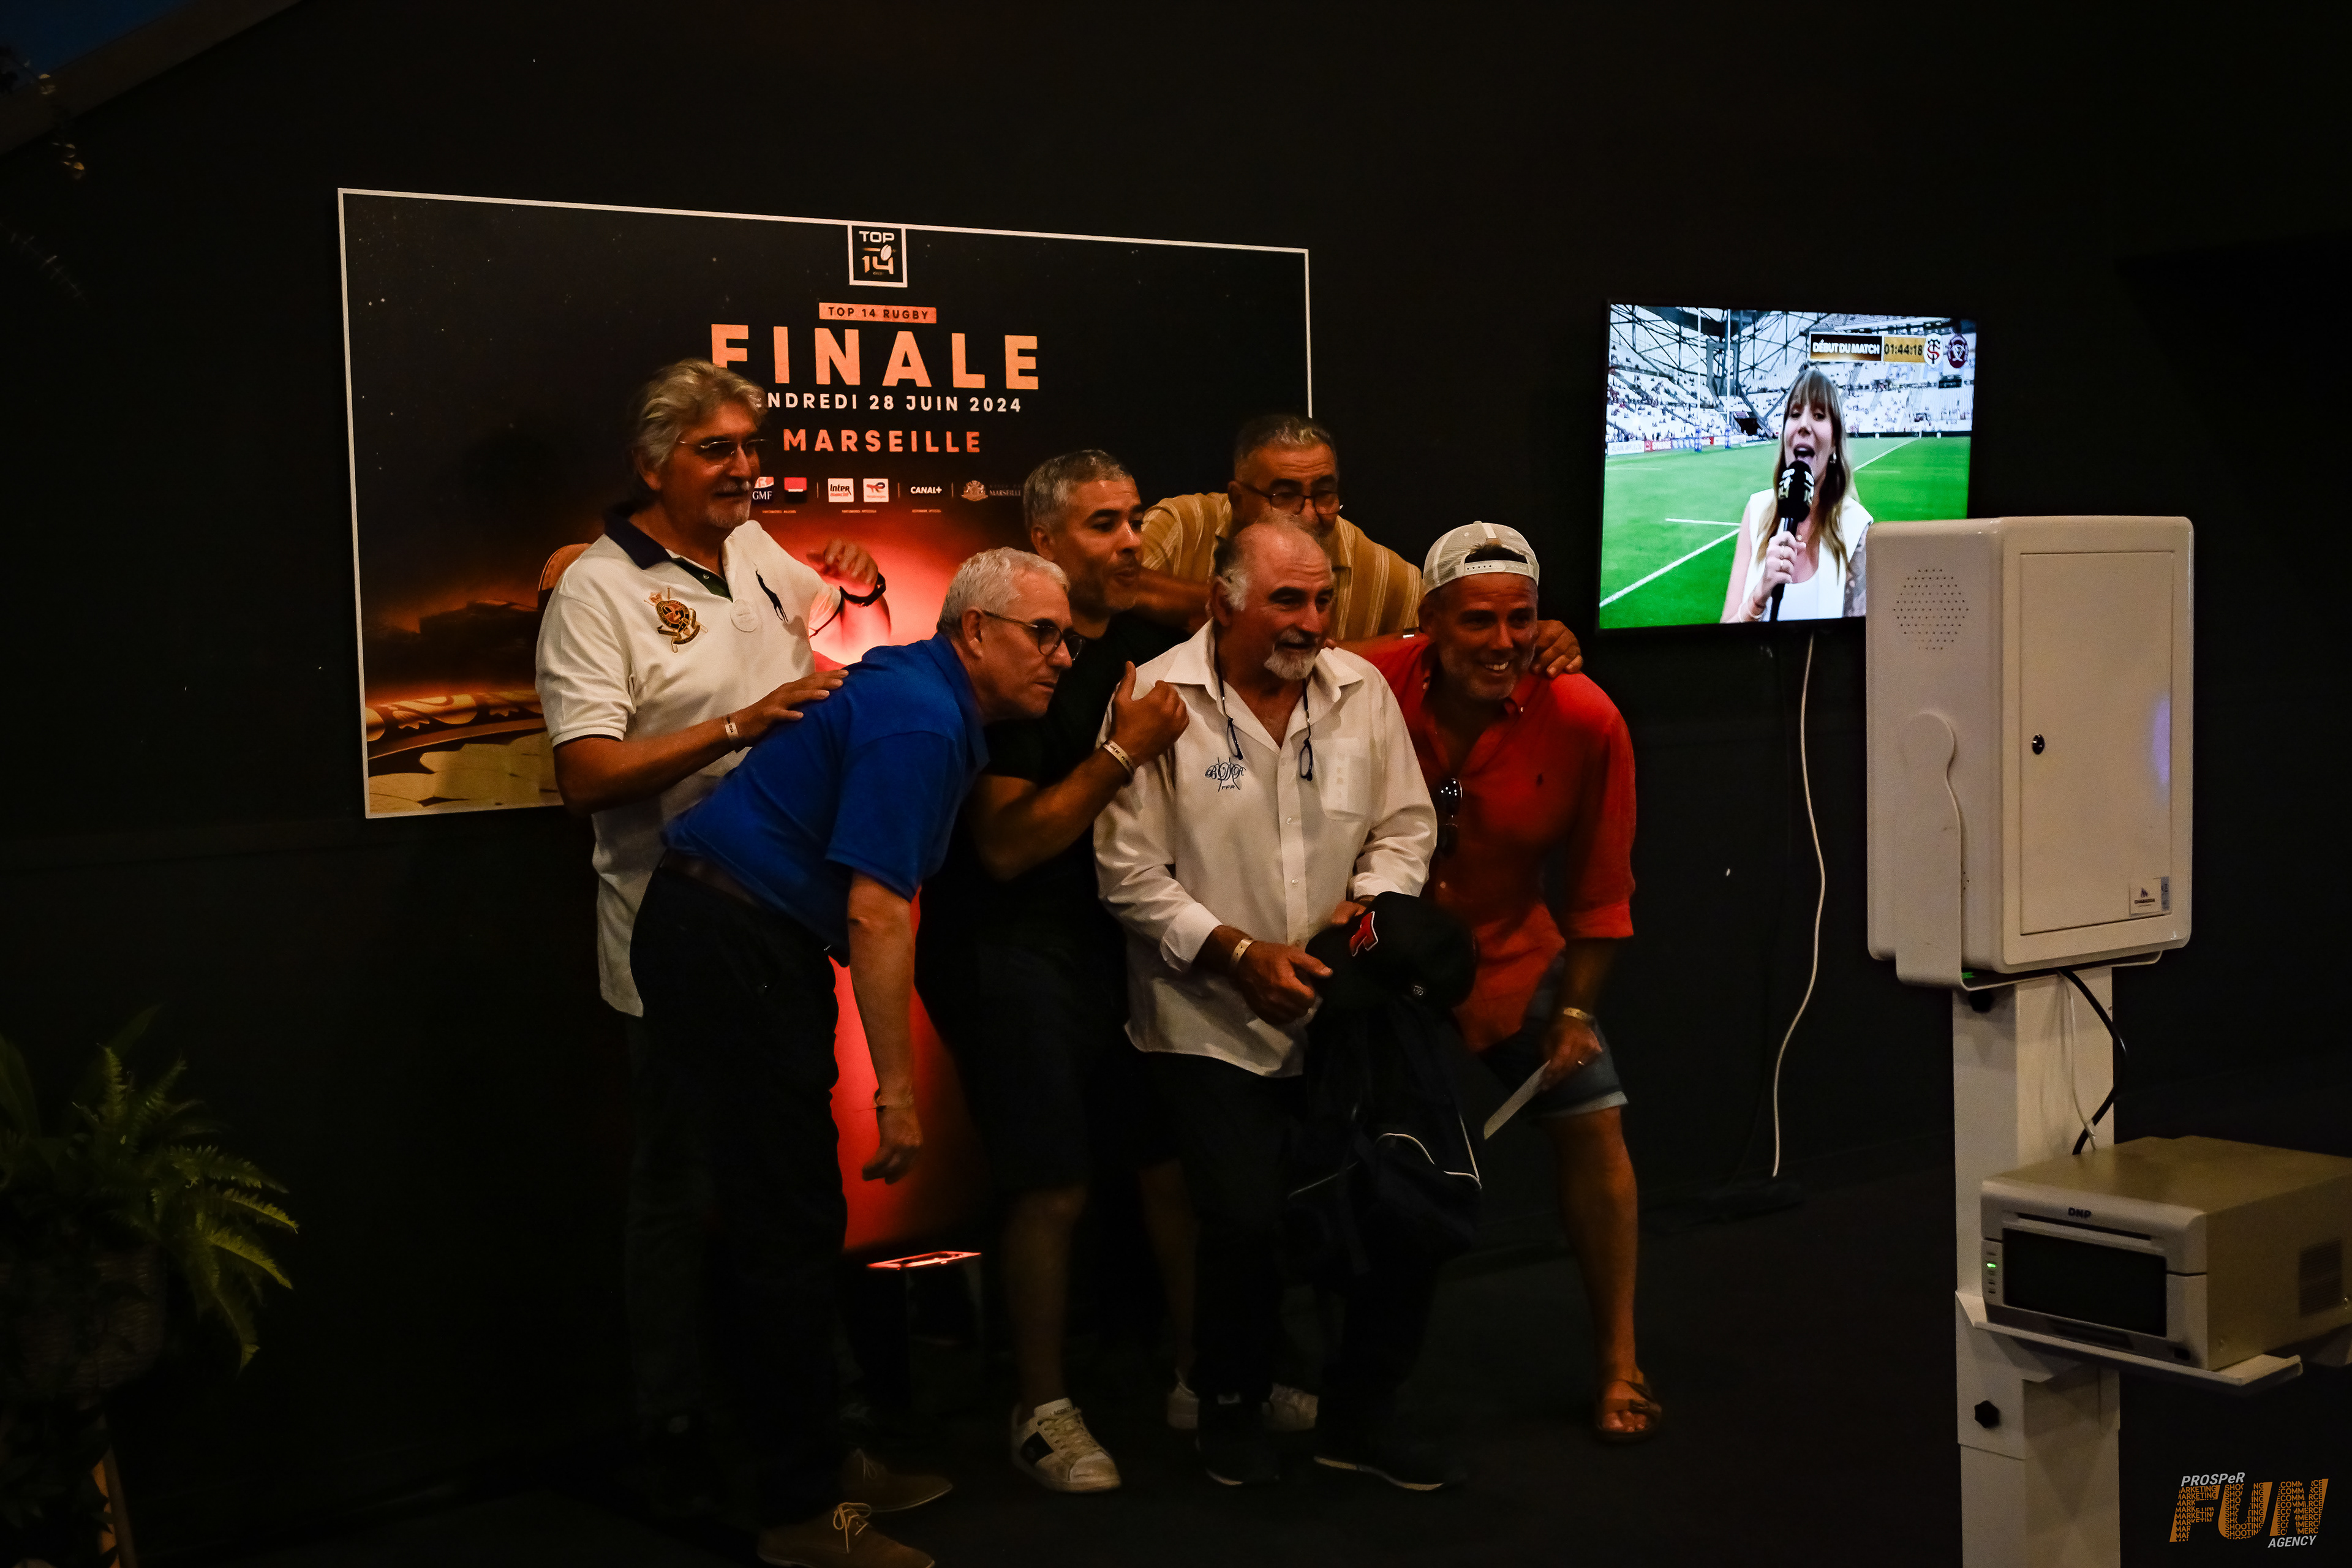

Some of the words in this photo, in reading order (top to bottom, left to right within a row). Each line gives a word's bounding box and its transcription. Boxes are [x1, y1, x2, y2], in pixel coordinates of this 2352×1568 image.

[859, 230, 895, 243] TOP
[861, 255, 894, 274] 14
[828, 306, 854, 317] TOP
[862, 308, 876, 318] 14
[883, 309, 928, 320] RUGBY
[1812, 339, 1839, 353] DÉBUT
[1839, 342, 1852, 353] DU
[1852, 343, 1880, 355] MATCH
[1884, 343, 1923, 356] 01:44:18
[711, 323, 1039, 390] FINALE
[752, 393, 858, 409] NDREDI
[870, 395, 894, 410] 28
[906, 396, 958, 412] JUIN
[970, 397, 1021, 413] 2024
[783, 429, 981, 453] MARSEILLE
[752, 491, 773, 500] GMF
[910, 486, 943, 494] CANAL+
[2068, 1207, 2092, 1218] DNP
